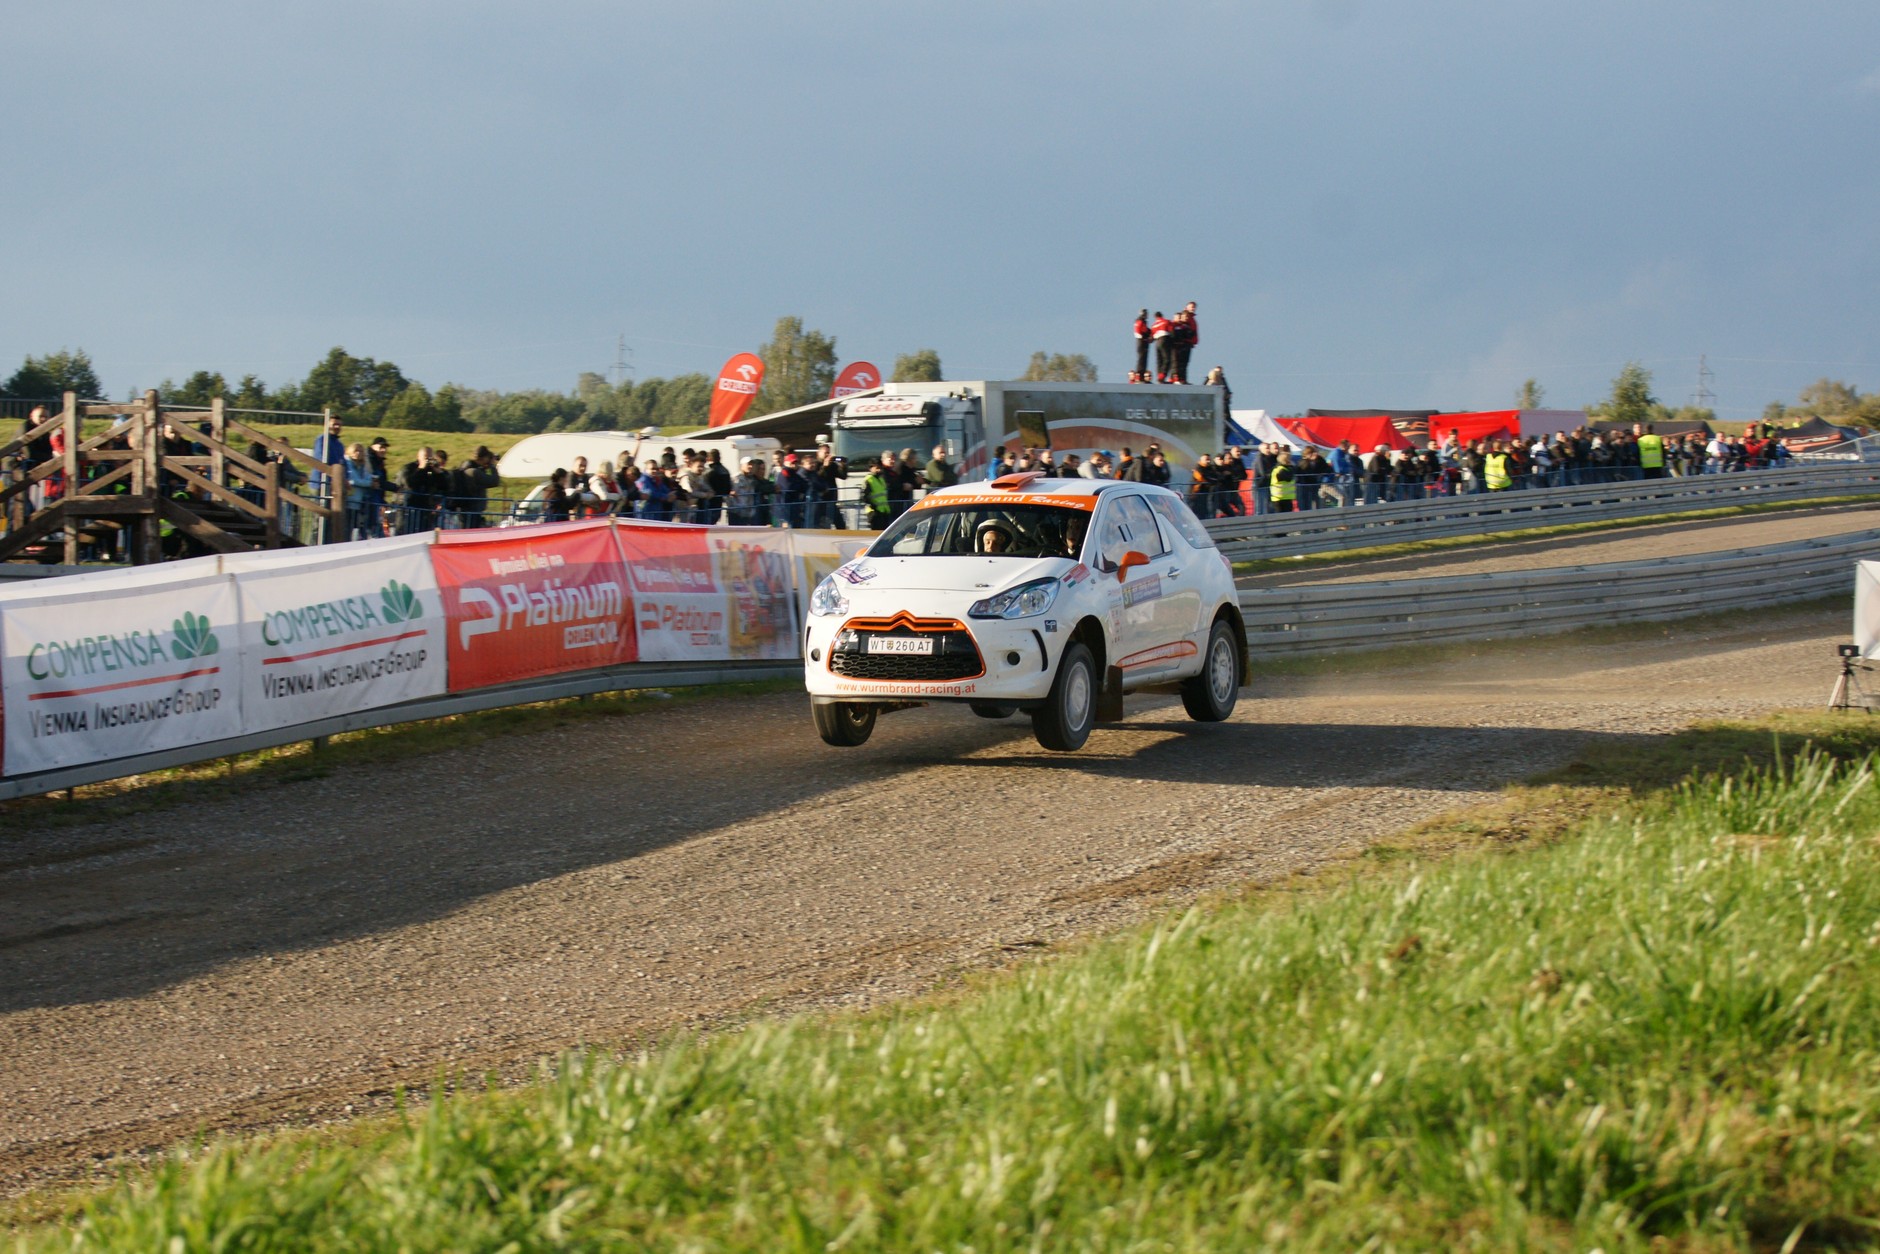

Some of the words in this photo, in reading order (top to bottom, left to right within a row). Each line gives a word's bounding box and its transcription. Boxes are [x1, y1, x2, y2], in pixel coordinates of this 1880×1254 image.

[855, 403, 913, 413] CESARO
[1126, 408, 1168, 419] DELTA
[1171, 408, 1214, 419] RALLY
[923, 494, 1025, 508] Wurmbrand
[1030, 495, 1086, 509] Racing
[500, 578, 623, 631] Platinum
[662, 604, 722, 631] Platinum
[262, 596, 382, 646] COMPENSA
[27, 629, 169, 680] COMPENSA
[871, 640, 885, 650] WT
[896, 640, 914, 652] 260
[917, 640, 932, 652] AT
[262, 672, 314, 699] VIENNA
[385, 649, 428, 675] GROUP
[835, 682, 976, 696] www.wurmbrand-racing.at
[28, 709, 88, 738] VIENNA
[94, 697, 172, 730] INSURANCE
[172, 688, 222, 716] GROUP
